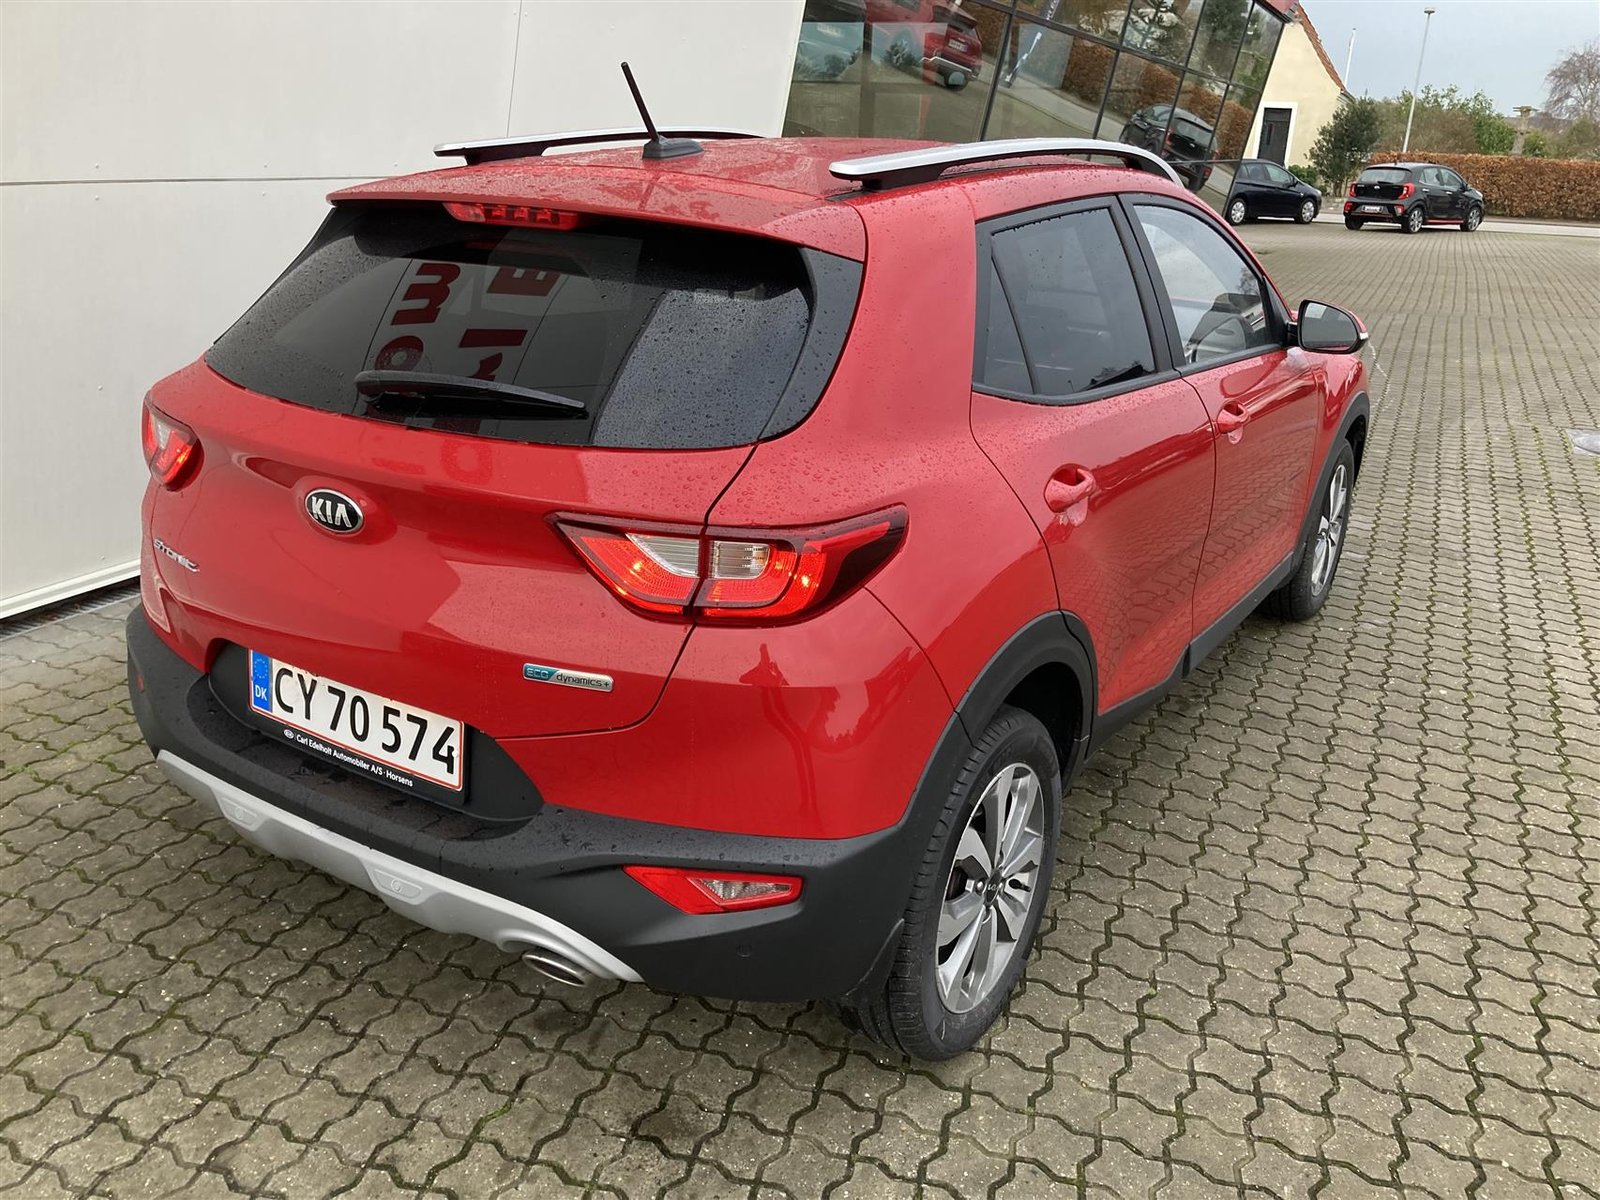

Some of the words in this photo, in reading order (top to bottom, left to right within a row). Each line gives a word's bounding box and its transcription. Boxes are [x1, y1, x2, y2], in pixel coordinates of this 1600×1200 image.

[311, 497, 352, 527] KIA
[526, 667, 549, 678] ECO
[255, 685, 268, 700] DK
[275, 668, 317, 720] CY
[328, 685, 370, 742] 70
[381, 705, 455, 774] 574
[296, 734, 308, 746] Carl
[333, 750, 370, 770] Automobiler
[386, 769, 413, 787] Horsens
